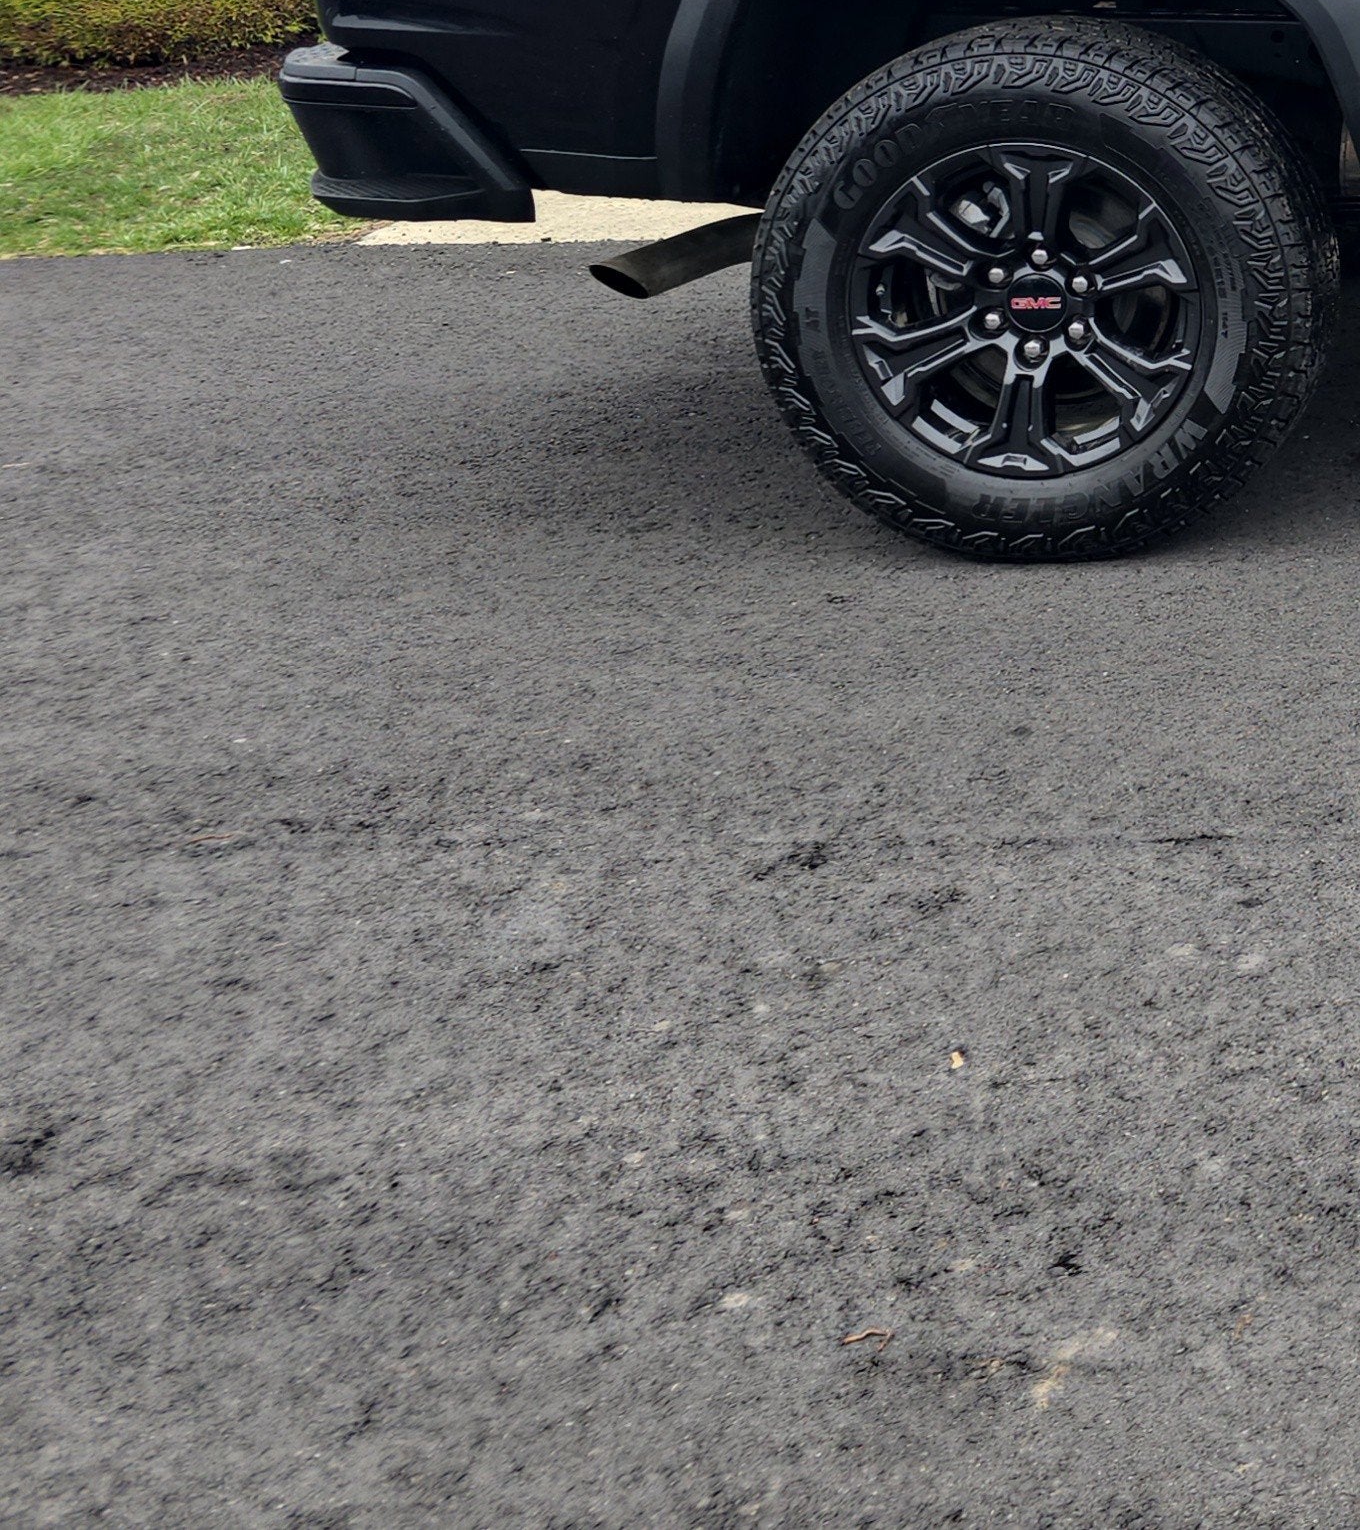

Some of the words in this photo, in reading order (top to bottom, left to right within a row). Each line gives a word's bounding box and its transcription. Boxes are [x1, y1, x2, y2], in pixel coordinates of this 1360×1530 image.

[833, 97, 1078, 210] GOODYEAR
[1011, 296, 1062, 310] GMC
[972, 418, 1208, 524] WRANGLER
